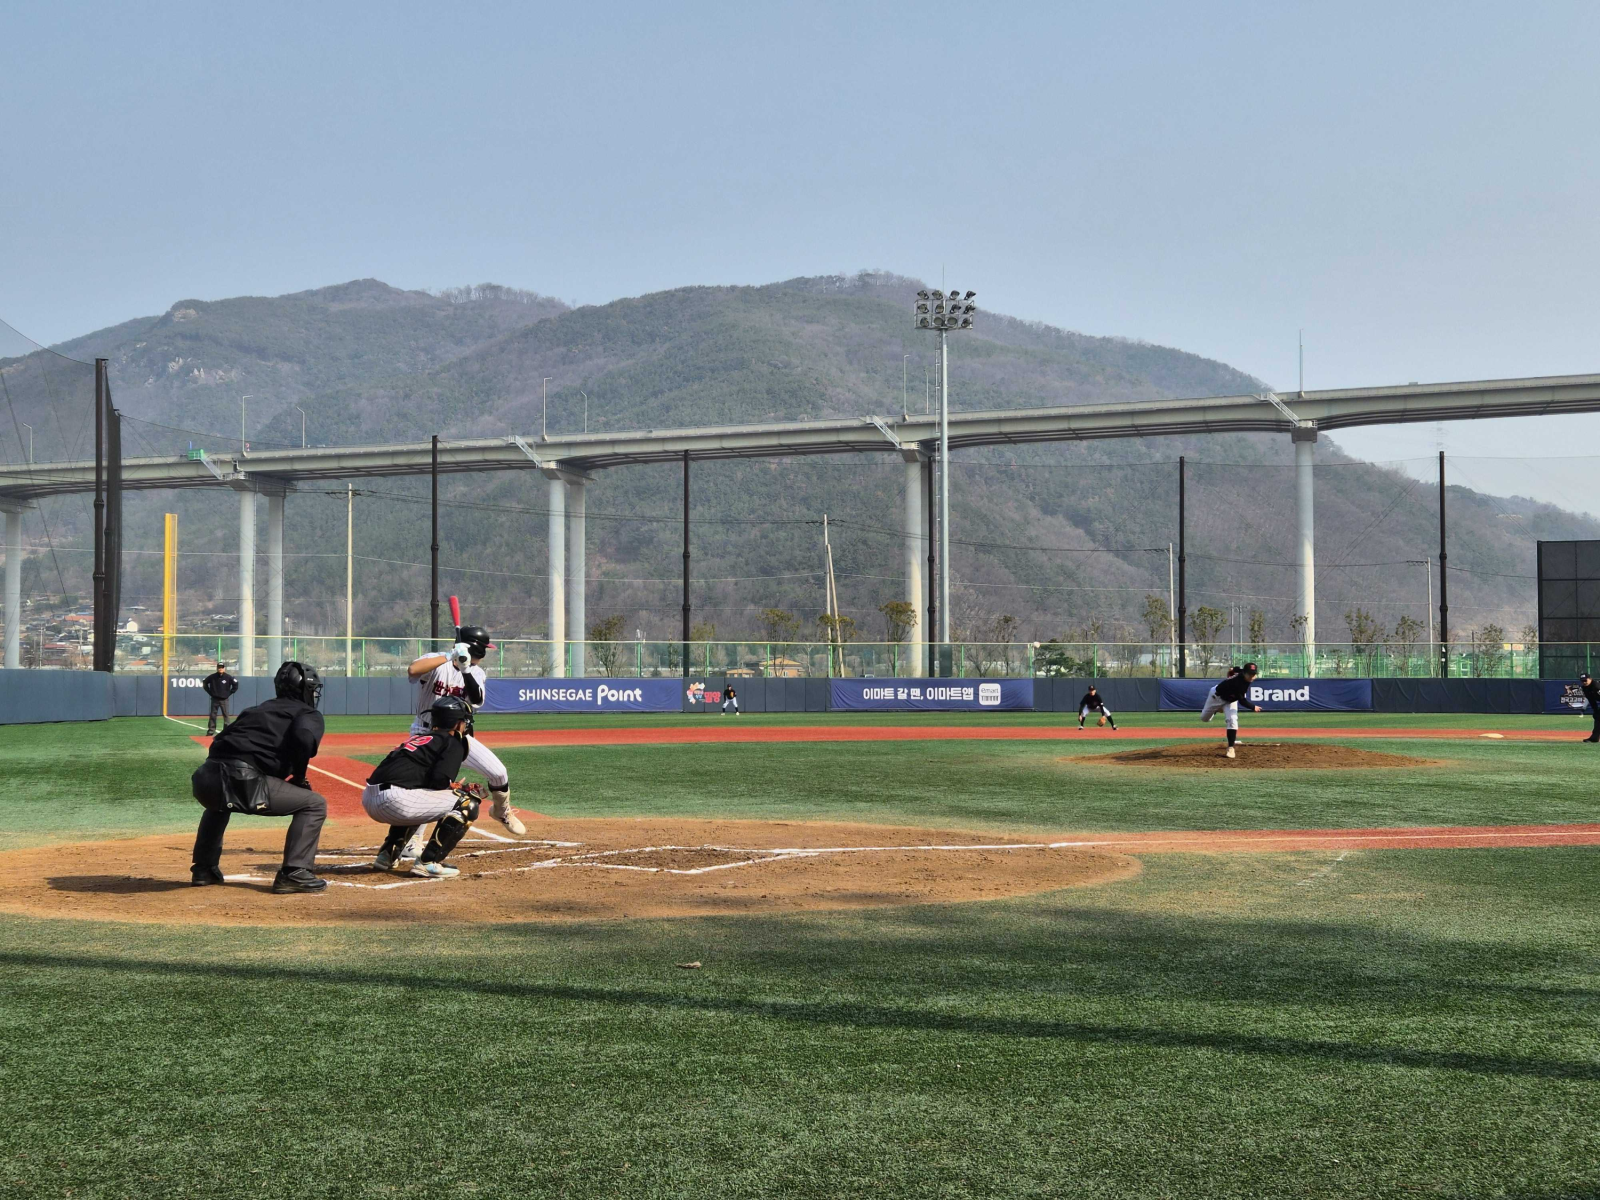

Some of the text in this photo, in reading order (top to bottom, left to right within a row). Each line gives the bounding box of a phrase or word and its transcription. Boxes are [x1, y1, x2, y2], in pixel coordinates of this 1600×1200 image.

[171, 678, 206, 688] 100M
[518, 684, 642, 705] SHINSEGAE Point
[863, 687, 895, 700] 이마트
[897, 687, 908, 700] 갈
[926, 687, 974, 700] 이마트앱
[1250, 685, 1310, 701] Brand
